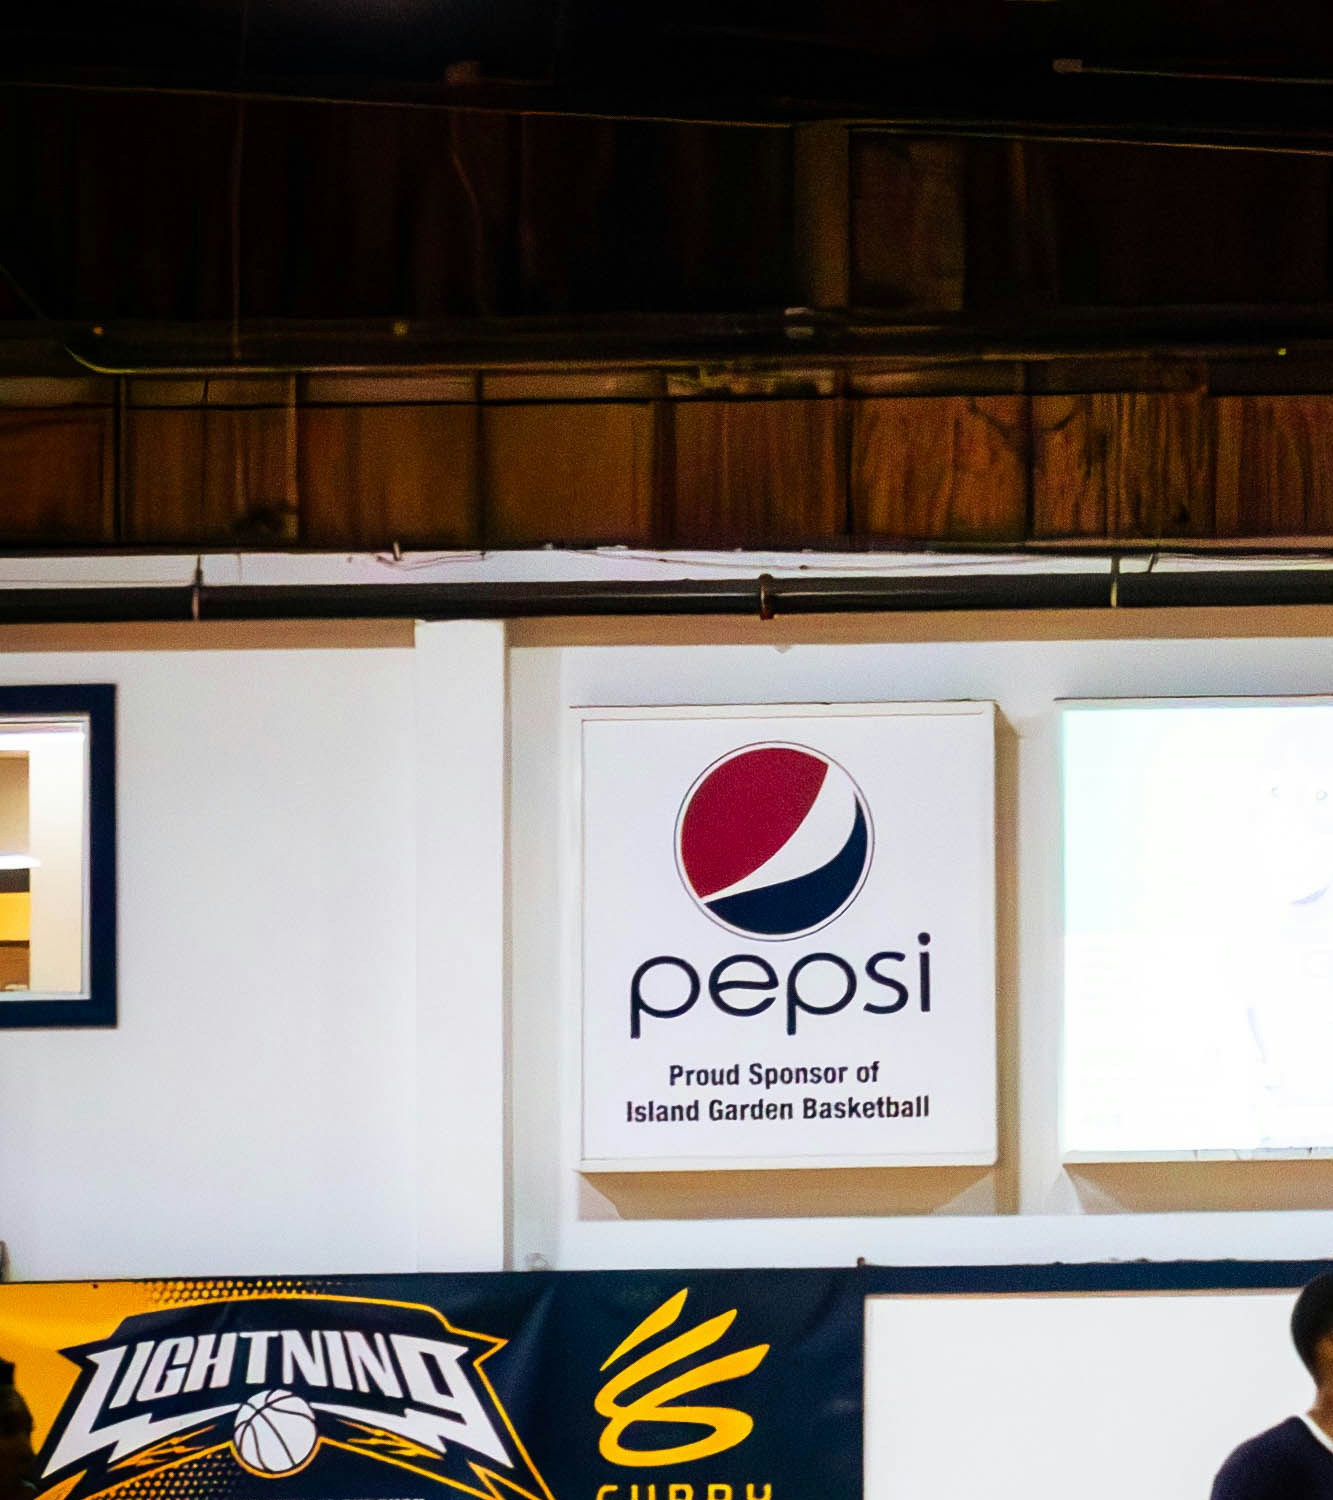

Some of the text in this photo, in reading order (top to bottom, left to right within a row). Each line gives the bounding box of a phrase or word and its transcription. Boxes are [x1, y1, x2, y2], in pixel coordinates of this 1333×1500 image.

[630, 932, 931, 1039] pepsi
[669, 1061, 880, 1089] Proud Sponsor of
[626, 1096, 929, 1122] Island Garden Basketball
[40, 1330, 514, 1479] LIGHTNING
